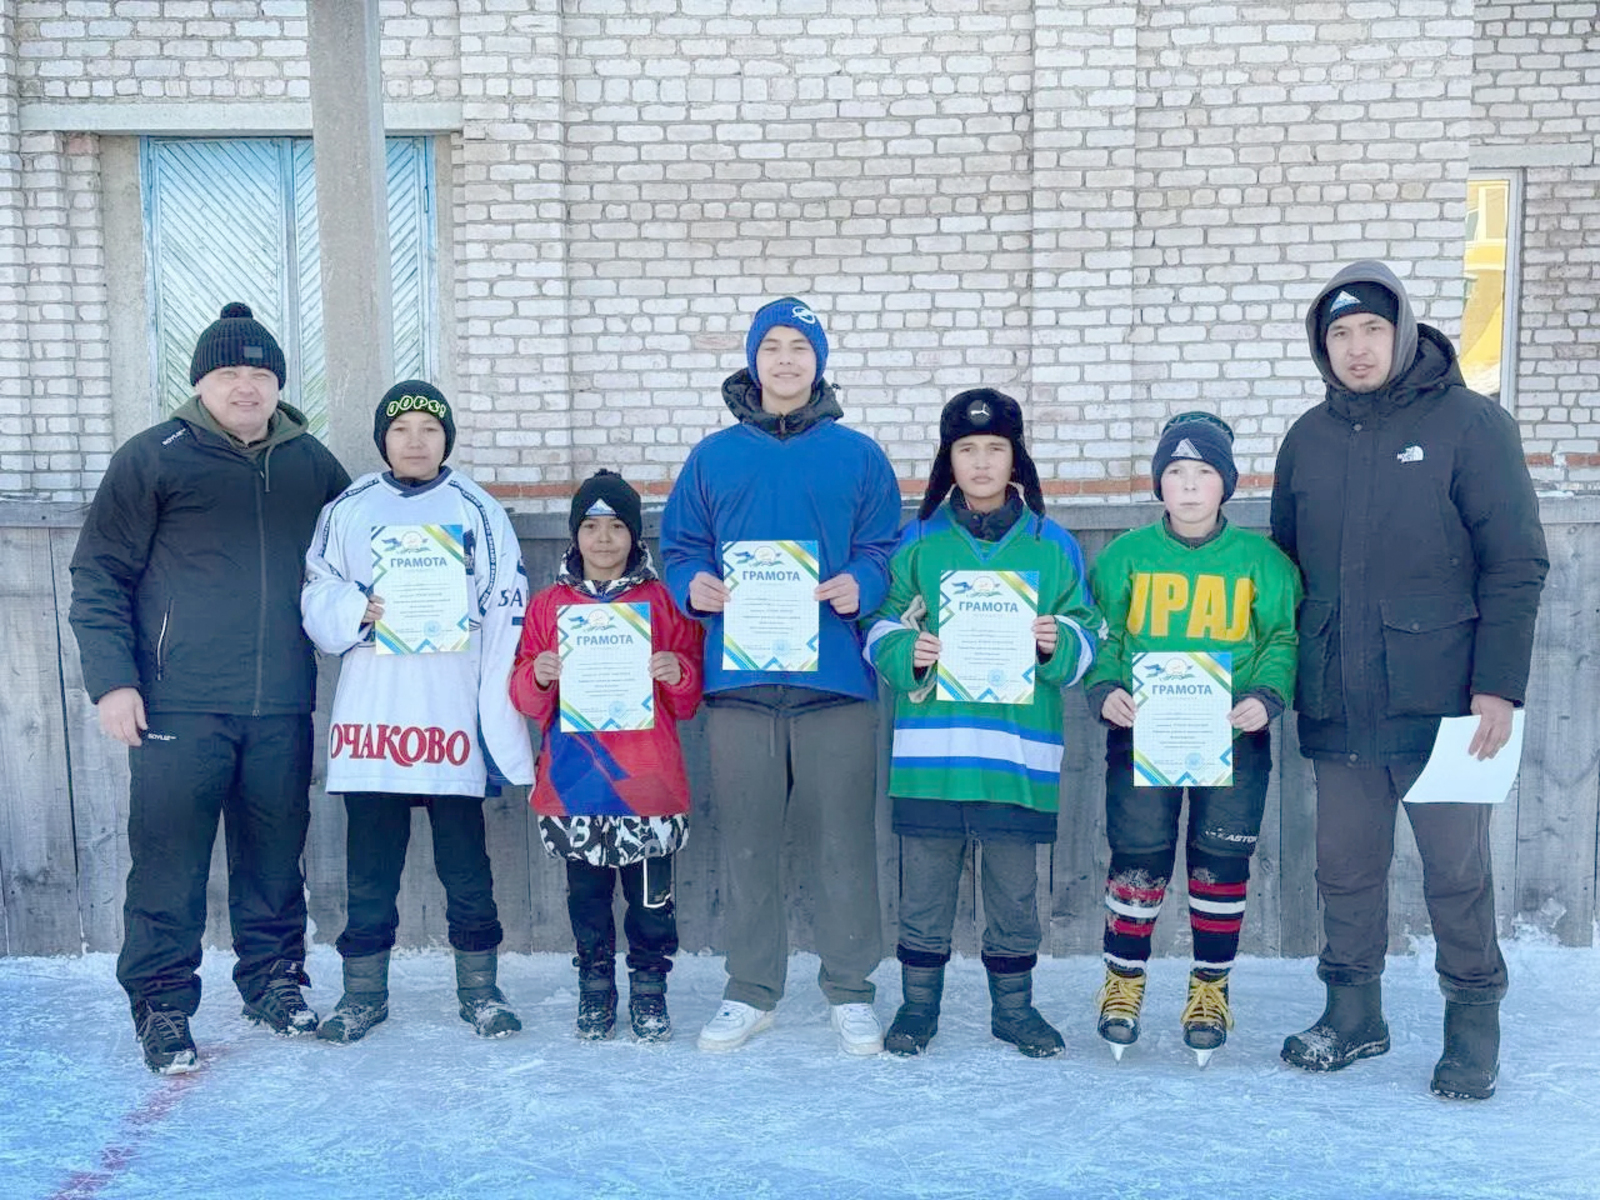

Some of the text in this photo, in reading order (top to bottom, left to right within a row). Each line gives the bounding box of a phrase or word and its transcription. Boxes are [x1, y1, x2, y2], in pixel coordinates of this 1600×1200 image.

[390, 556, 448, 568] ГРАМОТА
[742, 570, 801, 581] ГРАМОТА
[958, 601, 1019, 612] ГРАМОТА
[576, 634, 634, 646] ГРАМОТА
[1151, 684, 1213, 695] ГРАМОТА
[330, 722, 471, 767] ОЧАКОВО
